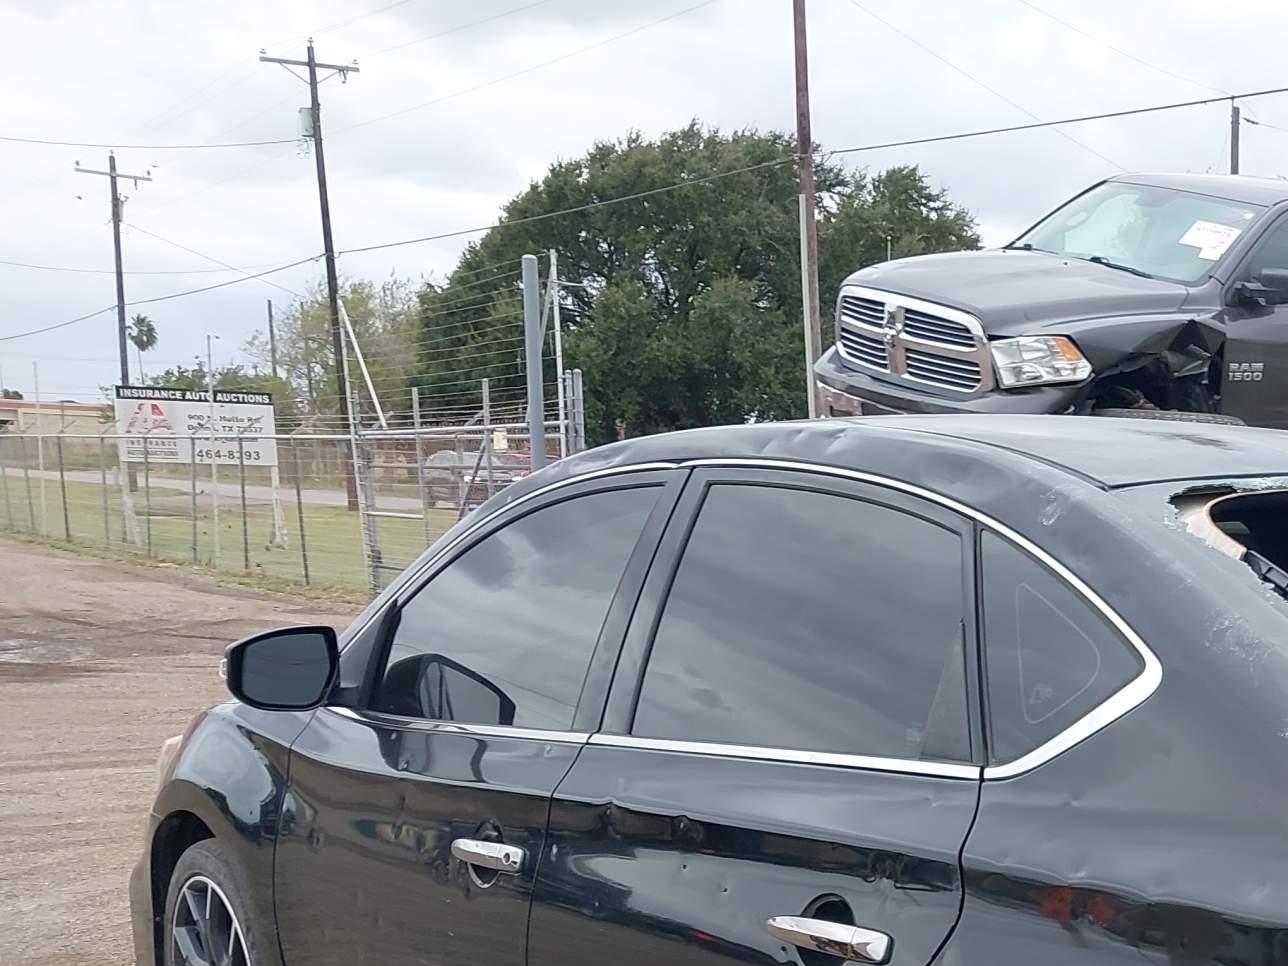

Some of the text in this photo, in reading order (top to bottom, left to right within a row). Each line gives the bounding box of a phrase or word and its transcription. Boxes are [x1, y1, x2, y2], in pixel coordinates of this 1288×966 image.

[1229, 363, 1264, 371] RAM
[1228, 372, 1263, 381] 1500
[119, 388, 183, 400] INSURANCE
[216, 393, 269, 403] AUCTIONS
